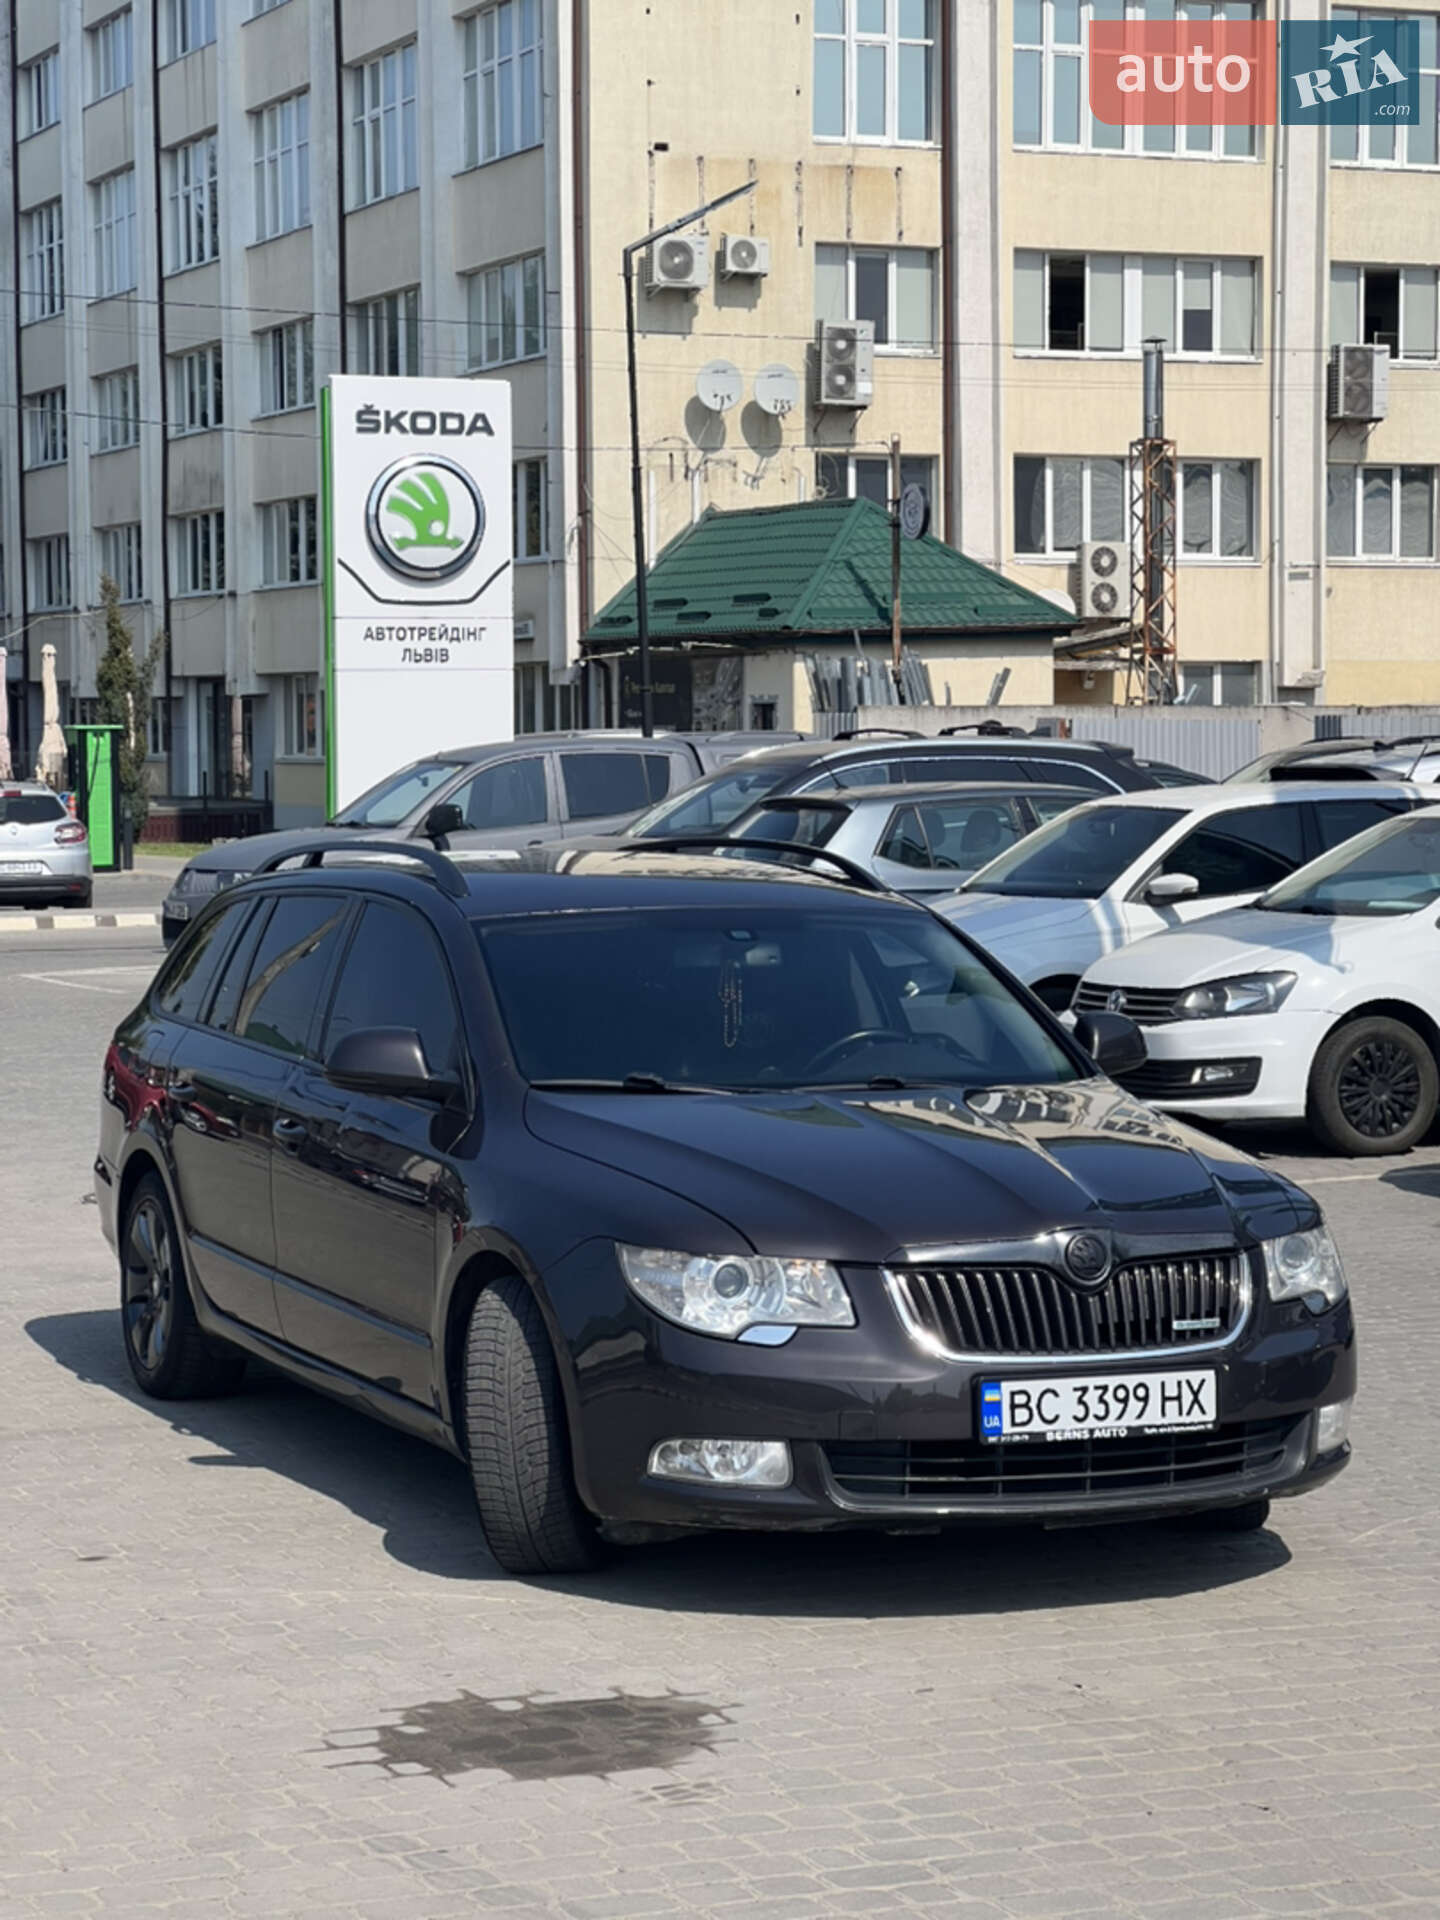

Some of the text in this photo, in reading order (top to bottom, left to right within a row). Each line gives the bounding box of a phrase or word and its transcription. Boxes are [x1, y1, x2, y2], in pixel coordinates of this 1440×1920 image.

[355, 404, 495, 437] ŠKODA
[363, 624, 487, 643] АВТОТРЕЙДІНГ
[401, 648, 450, 663] ЛЬВІВ
[1009, 1378, 1206, 1428] BC 3399 HX
[984, 1416, 1001, 1428] UA
[1093, 1428, 1128, 1439] AUTO
